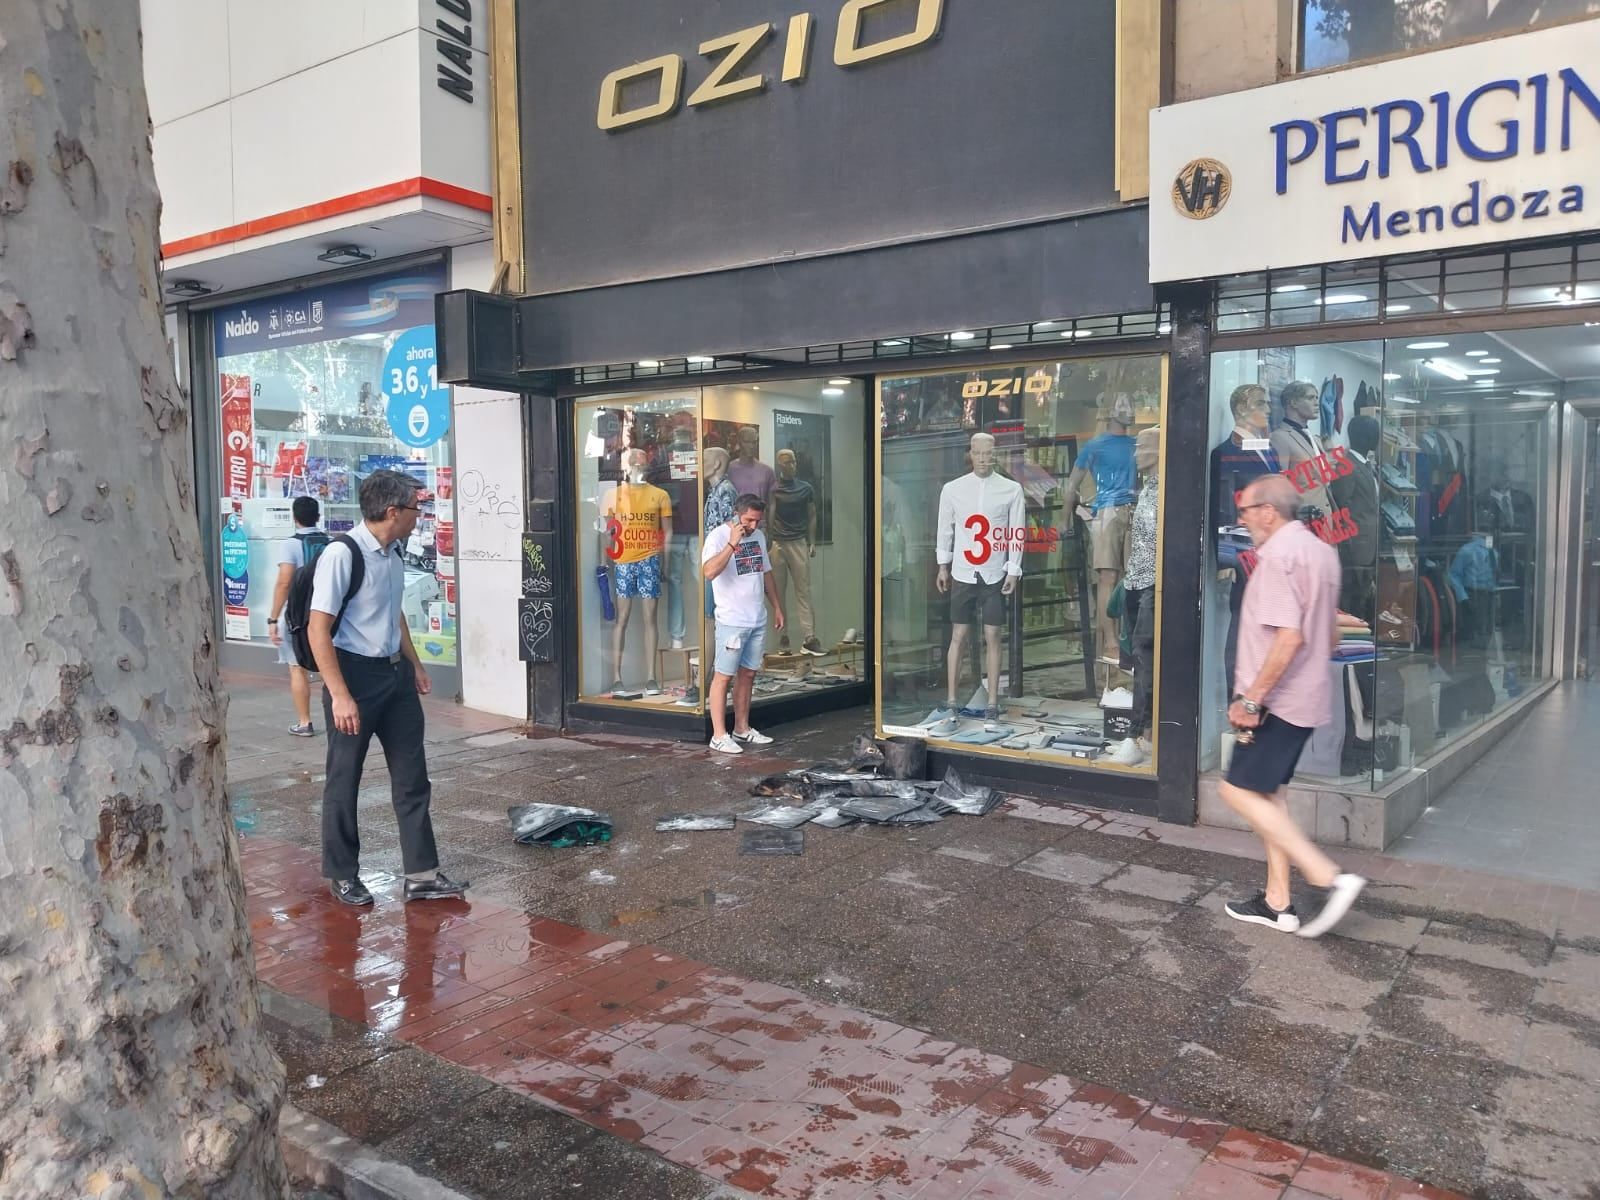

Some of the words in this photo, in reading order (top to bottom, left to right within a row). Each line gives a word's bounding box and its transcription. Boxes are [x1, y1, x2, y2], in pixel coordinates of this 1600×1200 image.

[597, 0, 946, 130] OZIO
[1341, 180, 1584, 244] Mendoza
[225, 315, 260, 339] Naldo
[406, 346, 434, 361] ahora
[420, 383, 428, 400] y
[962, 375, 1053, 399] OZIO
[620, 512, 657, 522] HOUSE
[606, 517, 625, 561] 3
[963, 513, 993, 566] 3
[992, 527, 1058, 541] CUOTAS
[624, 541, 636, 550] SIN
[992, 543, 1009, 552] SIN
